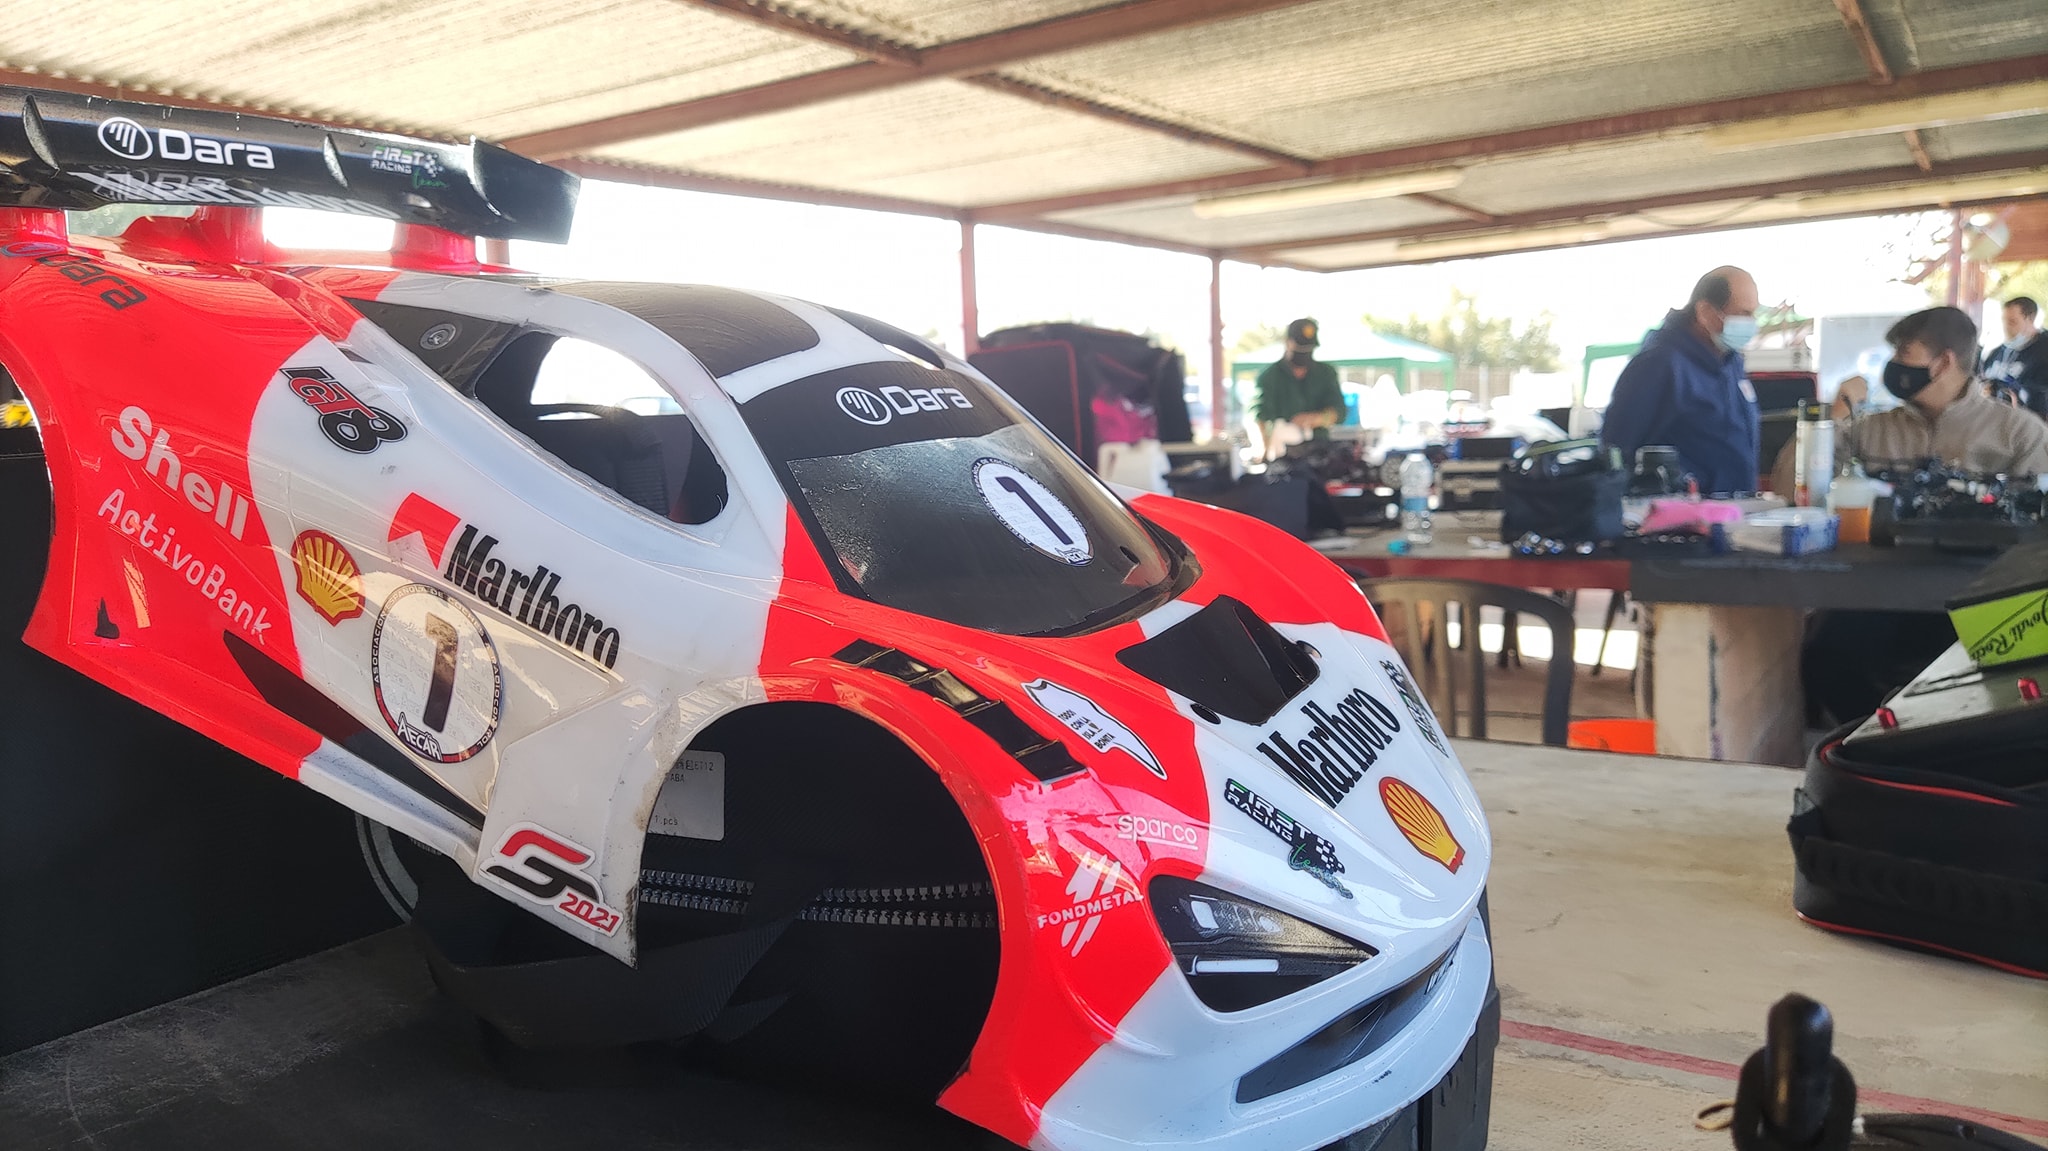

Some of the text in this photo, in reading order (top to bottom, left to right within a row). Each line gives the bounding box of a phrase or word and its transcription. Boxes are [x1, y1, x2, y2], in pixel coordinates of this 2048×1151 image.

[158, 128, 275, 170] Dara
[370, 159, 412, 175] RACING
[371, 145, 424, 165] FIRST
[35, 253, 147, 310] Dara
[879, 386, 974, 415] Dara
[111, 406, 249, 541] Shell
[98, 489, 272, 646] ActivoBank
[443, 524, 620, 673] Marlboro
[397, 712, 442, 761] AECAR
[1256, 688, 1400, 809] Marlboro
[1117, 814, 1198, 844] sparco
[1227, 793, 1293, 843] RACING
[1229, 780, 1312, 840] FIRST
[559, 892, 620, 933] 2021
[1037, 890, 1144, 929] FONDMETAL
